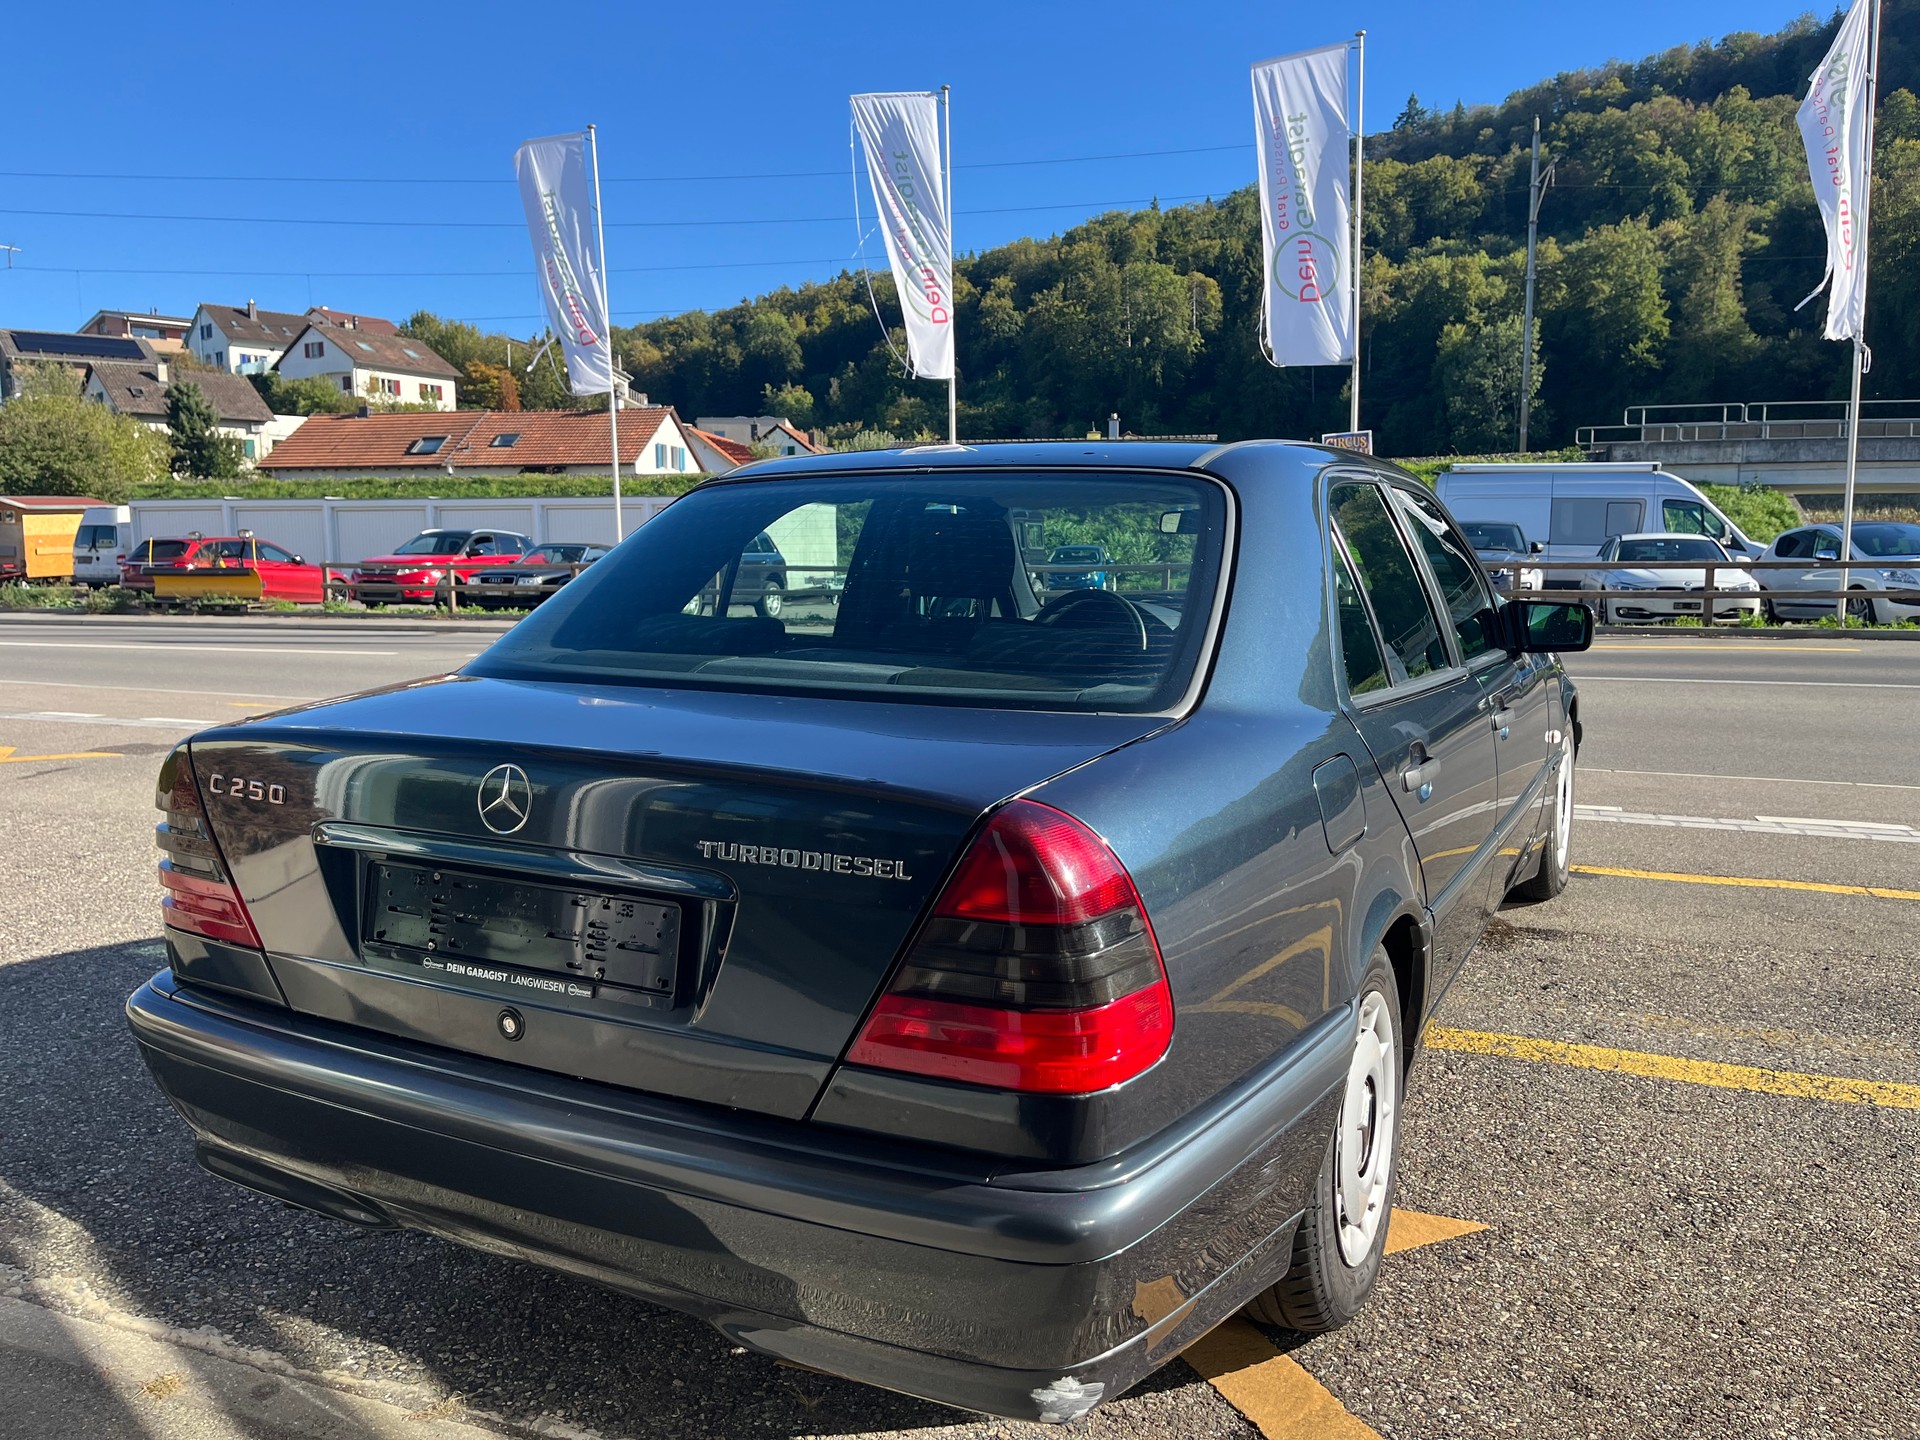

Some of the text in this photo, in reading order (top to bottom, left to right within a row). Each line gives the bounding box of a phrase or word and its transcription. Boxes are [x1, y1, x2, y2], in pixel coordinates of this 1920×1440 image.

[1325, 436, 1367, 449] CIRCUS
[209, 773, 288, 805] C 250
[698, 839, 913, 881] TURBODIESEL
[446, 962, 466, 975] DEIN
[466, 966, 508, 982] GARAGIST
[510, 974, 566, 993] LANGWIESEN
